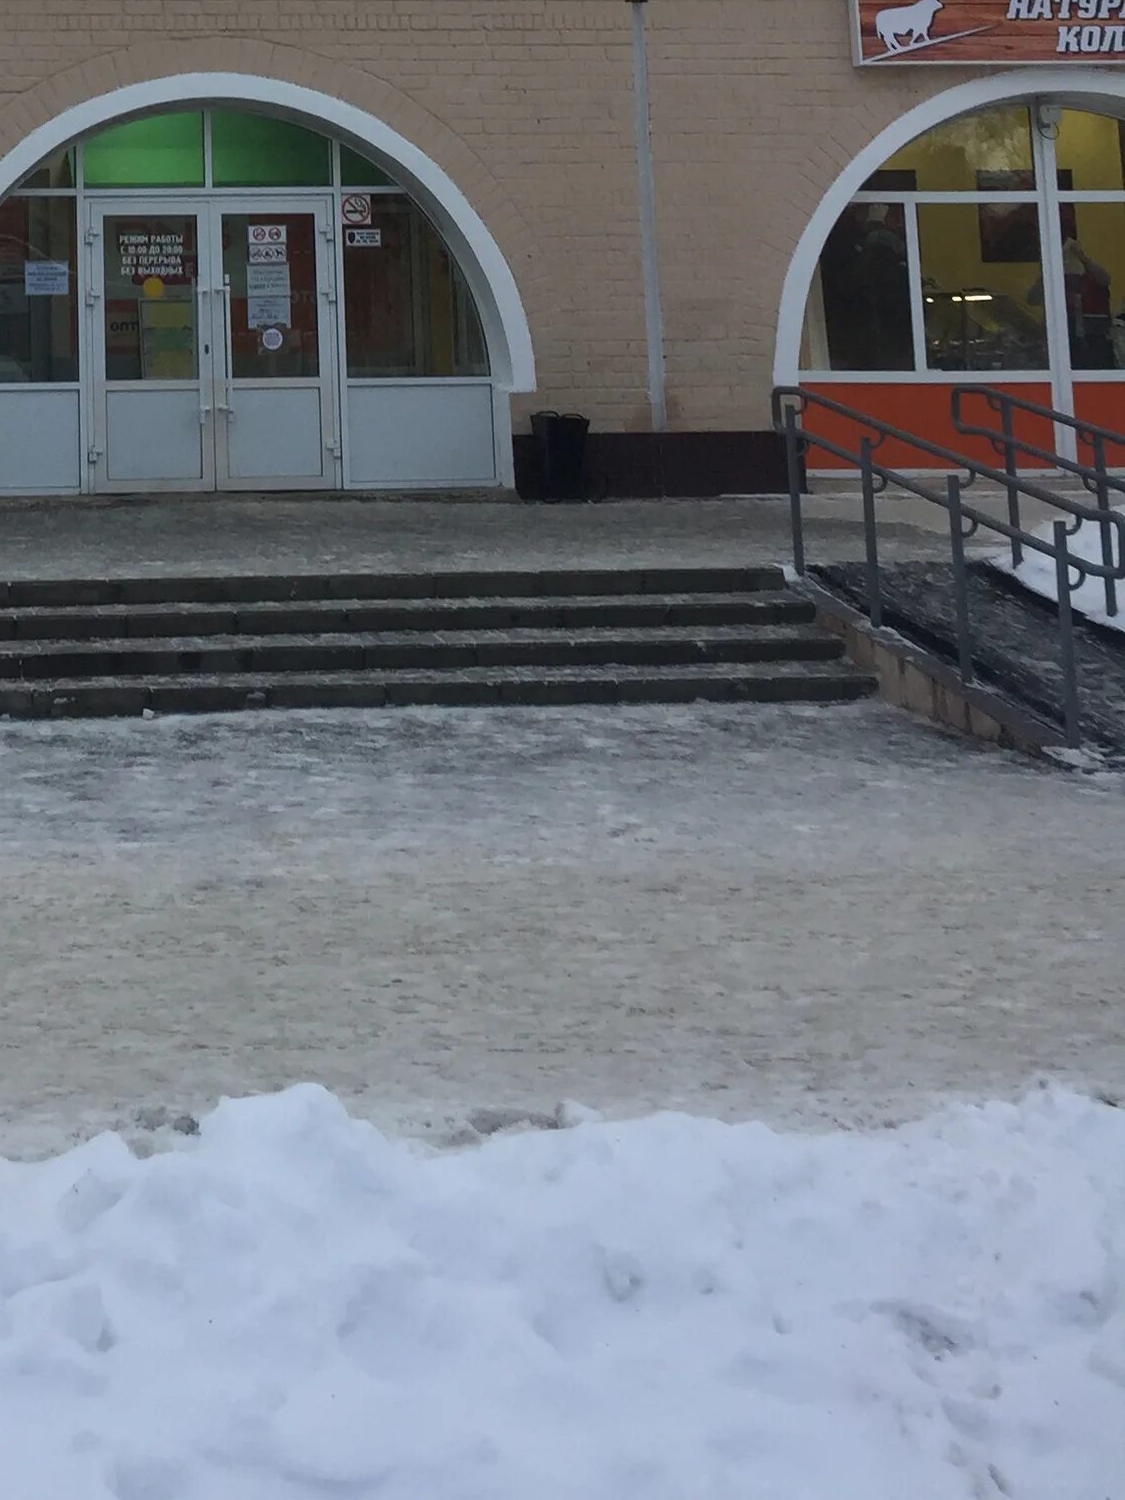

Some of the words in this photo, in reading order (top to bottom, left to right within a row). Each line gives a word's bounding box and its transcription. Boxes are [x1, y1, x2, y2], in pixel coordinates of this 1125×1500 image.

[150, 234, 183, 244] РАБОТЫ
[122, 256, 137, 264] БЕЗ
[139, 256, 182, 264] ПЕРЕРЫВА
[120, 266, 135, 275] БЕЗ
[138, 266, 183, 275] ВЫХОДНЫХ
